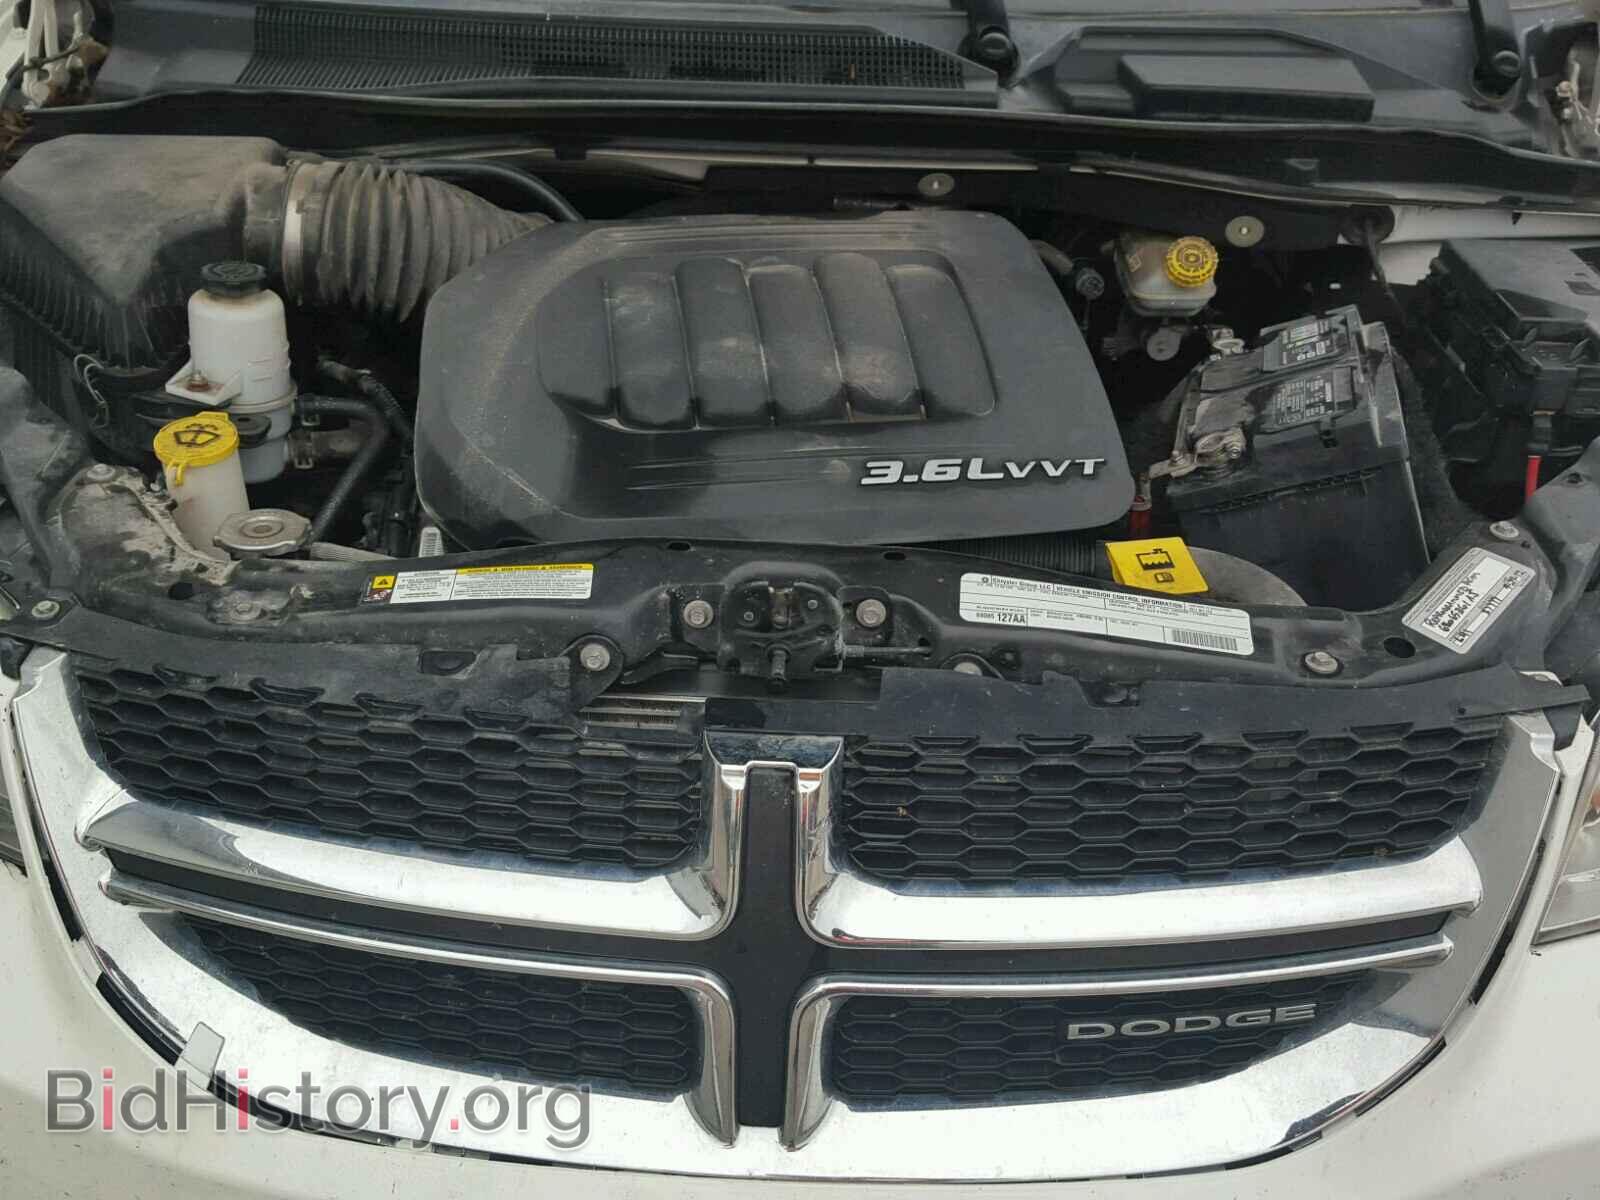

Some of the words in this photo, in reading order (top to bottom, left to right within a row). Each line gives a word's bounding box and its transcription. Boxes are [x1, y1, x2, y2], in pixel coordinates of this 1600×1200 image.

[1081, 590, 1111, 599] EMISSION
[997, 612, 1026, 624] 127AA
[1067, 1003, 1317, 1040] DODGE
